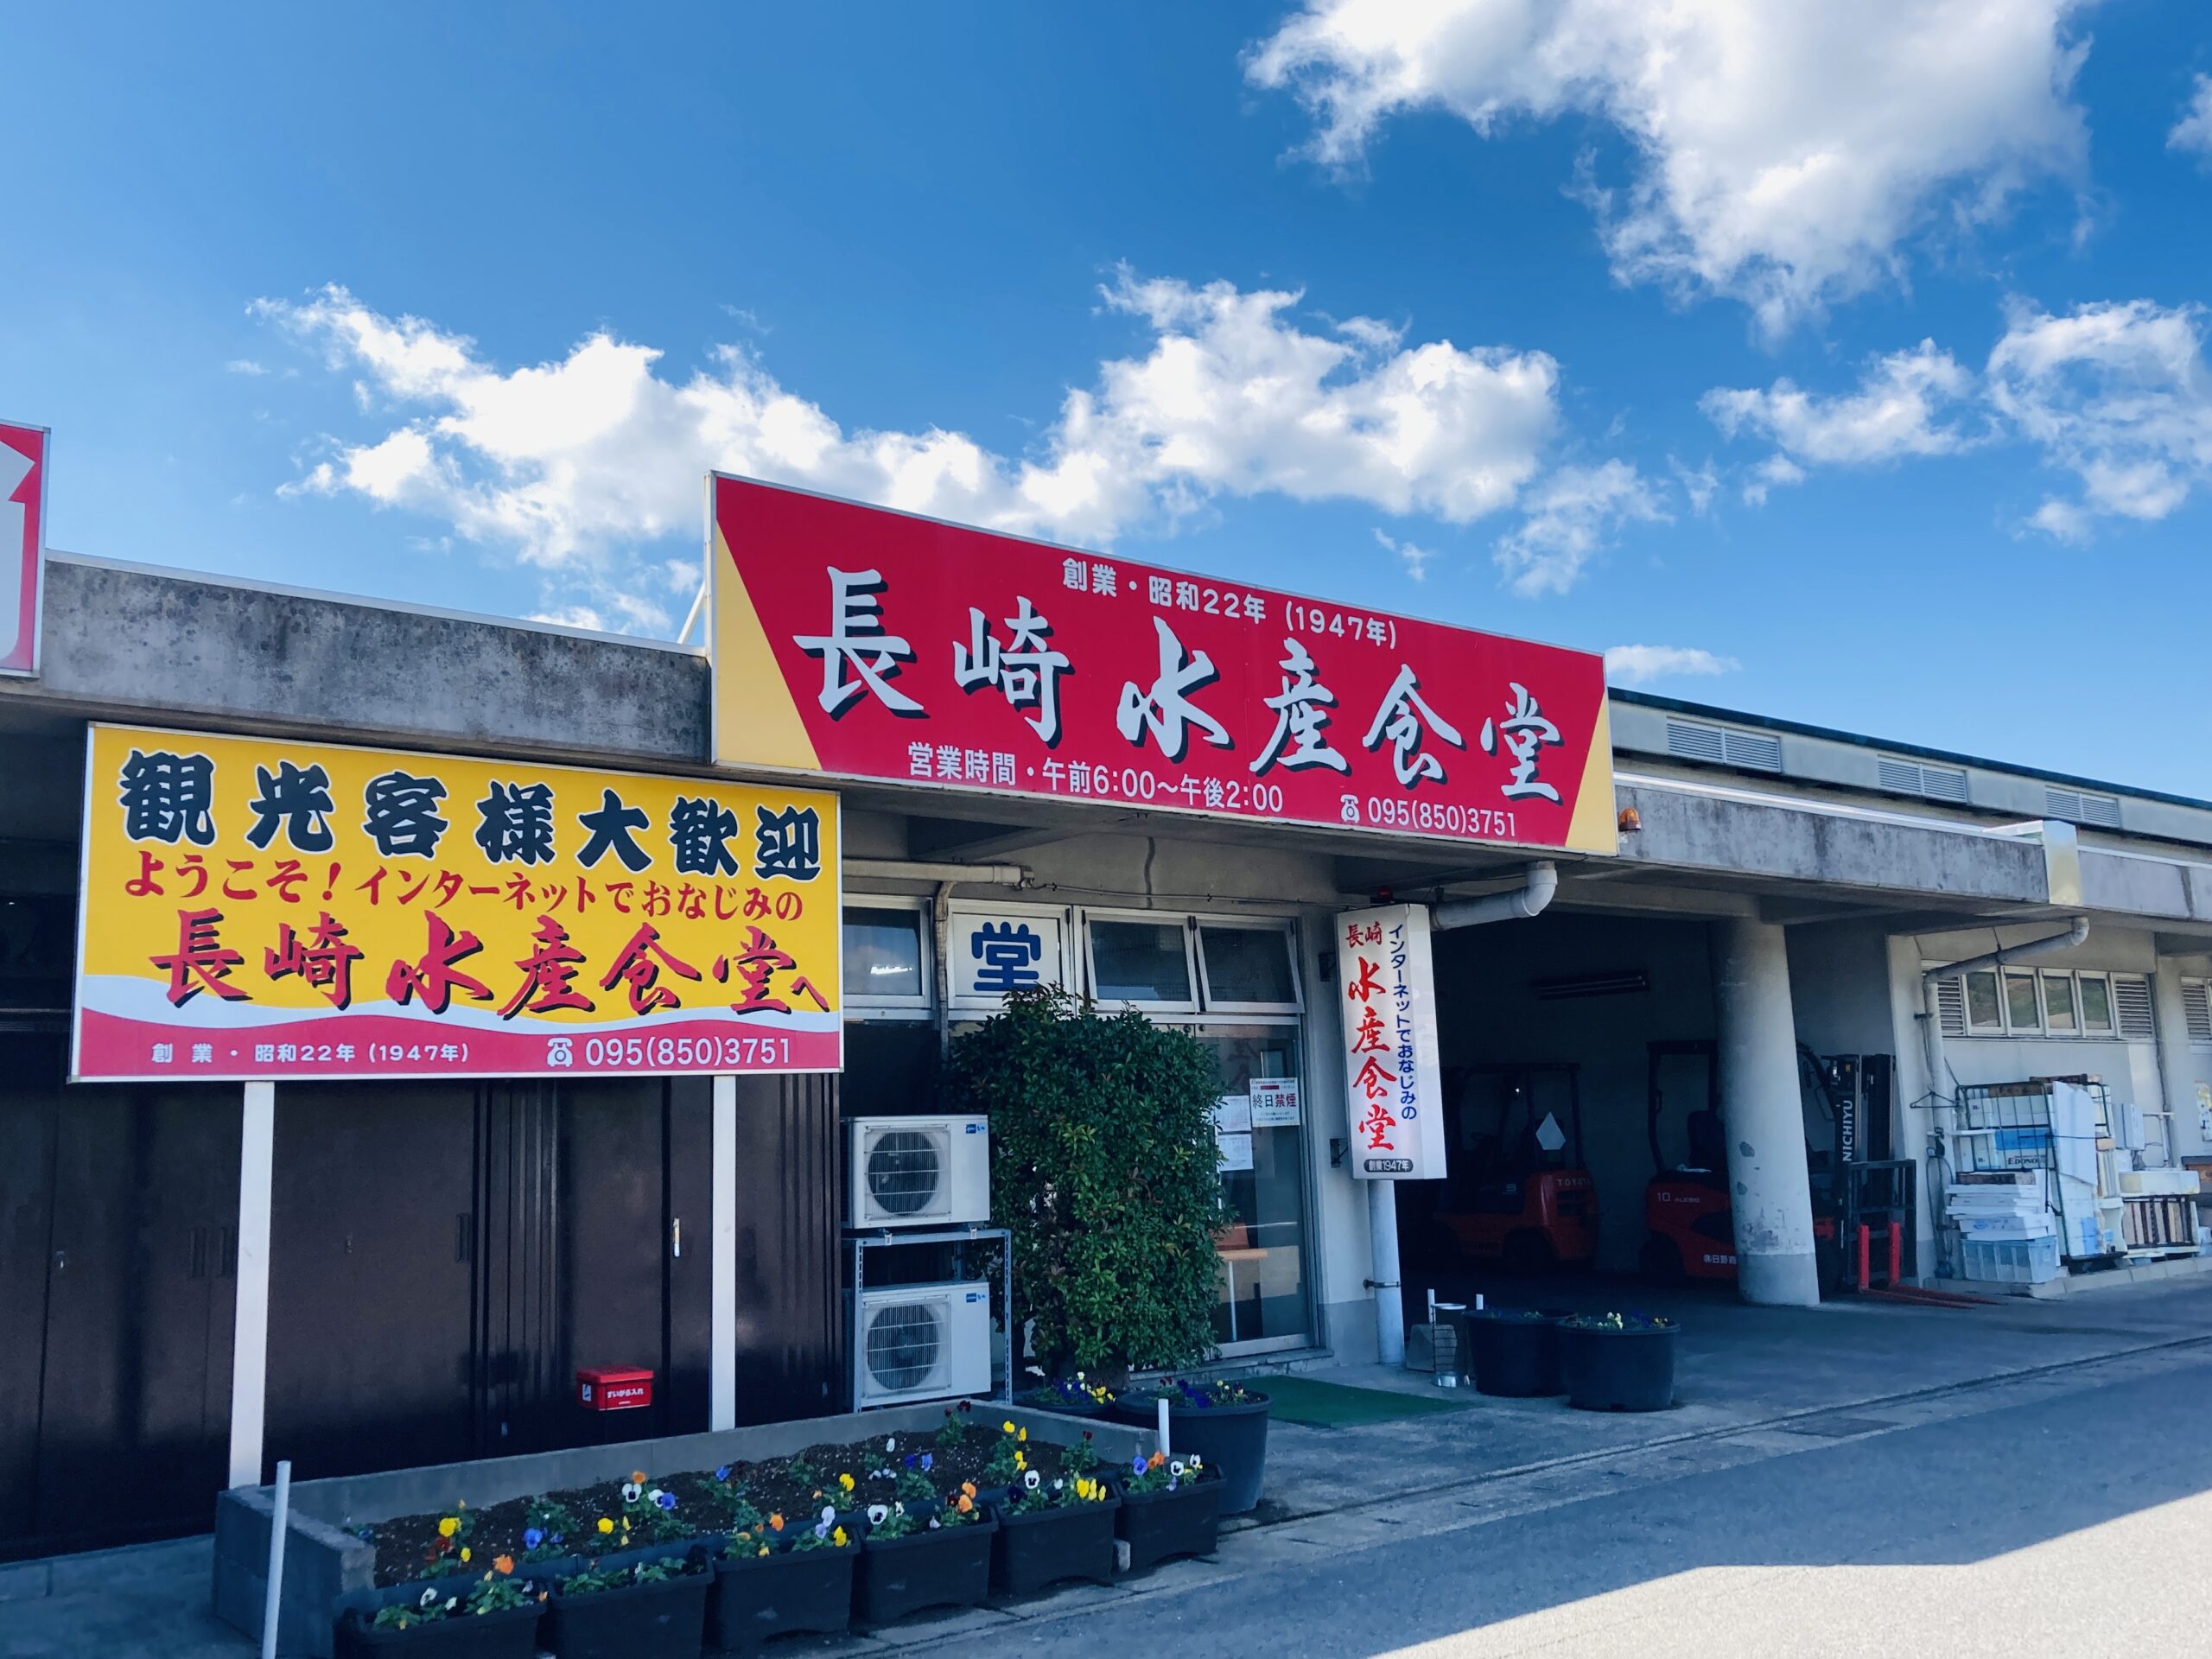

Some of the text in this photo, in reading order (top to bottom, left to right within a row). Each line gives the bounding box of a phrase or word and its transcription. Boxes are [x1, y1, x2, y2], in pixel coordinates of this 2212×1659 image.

[1063, 557, 1396, 649] 創業・昭和22年 (1947年)
[792, 567, 1561, 804] 長崎水産食堂
[118, 748, 822, 881] 観光客様大歓迎
[1369, 796, 1516, 837] 095(850)3751
[149, 908, 831, 1018] 長崎水産食堂へ
[971, 922, 1041, 992] 堂
[1345, 921, 1383, 948] 長崎
[368, 1042, 469, 1064] (1947年)
[585, 1036, 791, 1066] 095(850)3751
[1347, 957, 1397, 1151] 水産食堂
[1389, 924, 1418, 1121] インターネットでおなじみの
[1252, 1092, 1297, 1109] 終日禁煙
[1842, 1100, 1853, 1161] NICHIYU
